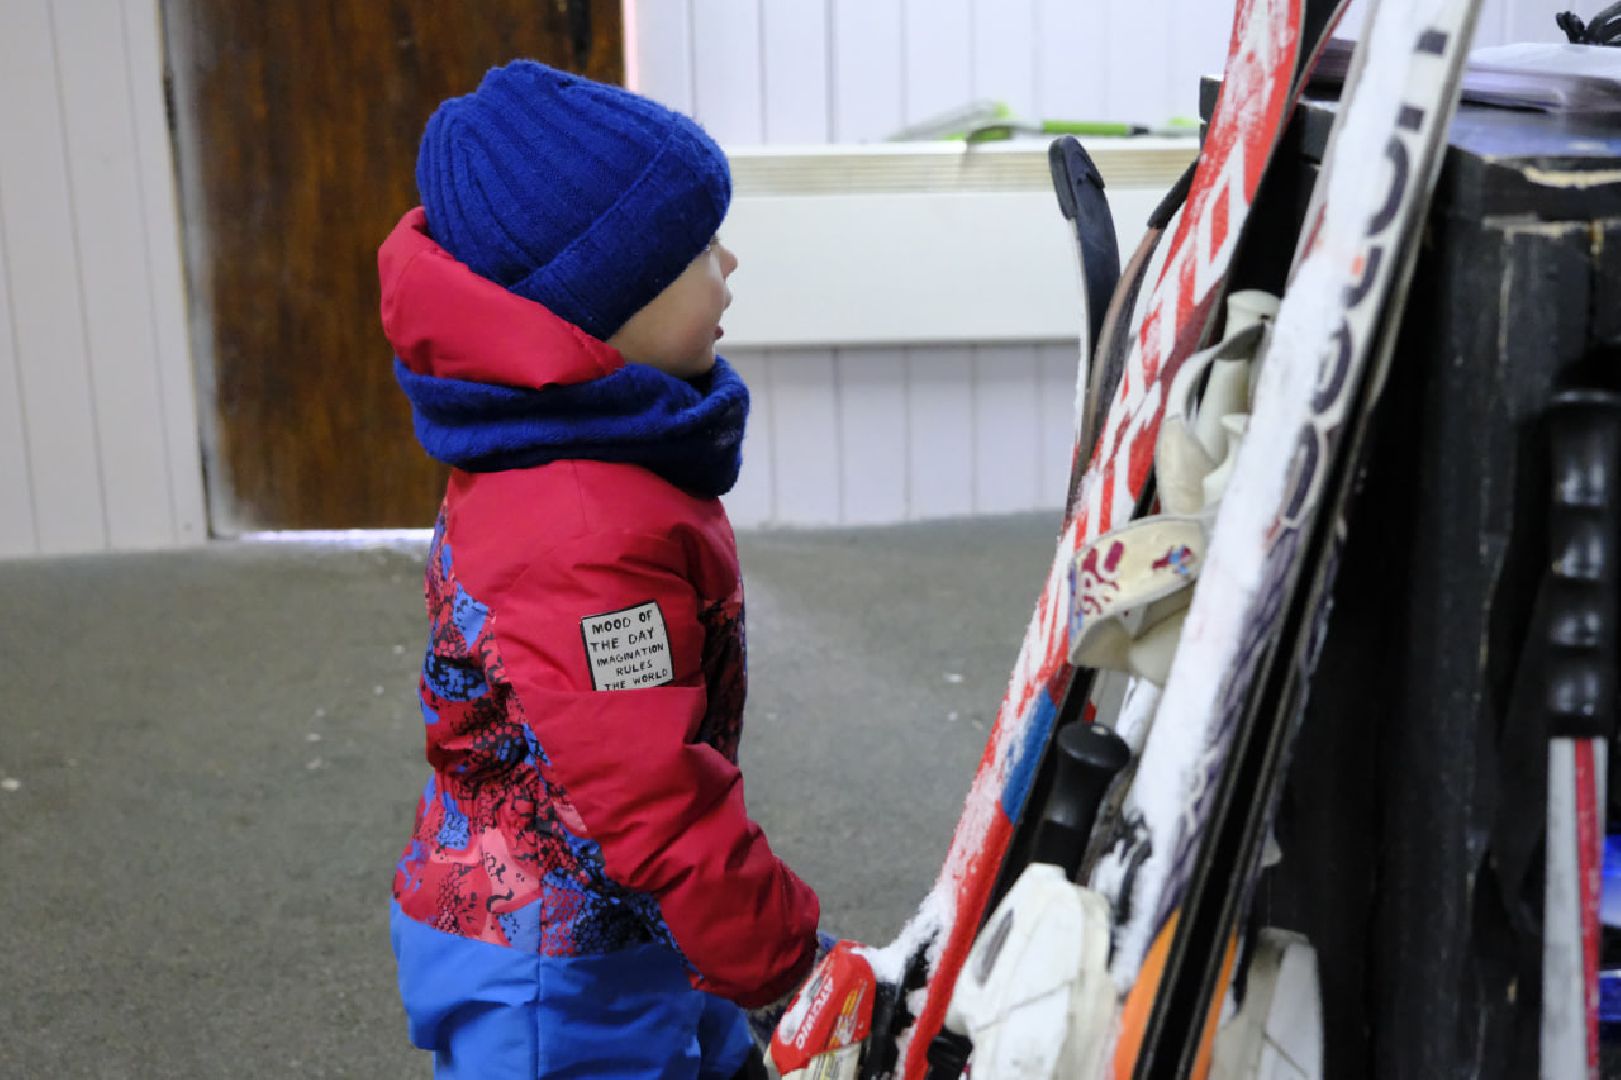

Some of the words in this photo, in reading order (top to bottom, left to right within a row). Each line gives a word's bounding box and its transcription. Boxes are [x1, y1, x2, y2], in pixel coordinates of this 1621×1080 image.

[592, 617, 631, 635] MOOD
[639, 610, 653, 622] OF
[590, 638, 619, 653] THE
[629, 627, 654, 645] DAY
[597, 643, 664, 667] IMAGINATION
[604, 681, 626, 691] THE
[633, 669, 668, 685] WORLD
[616, 660, 653, 677] RULES
